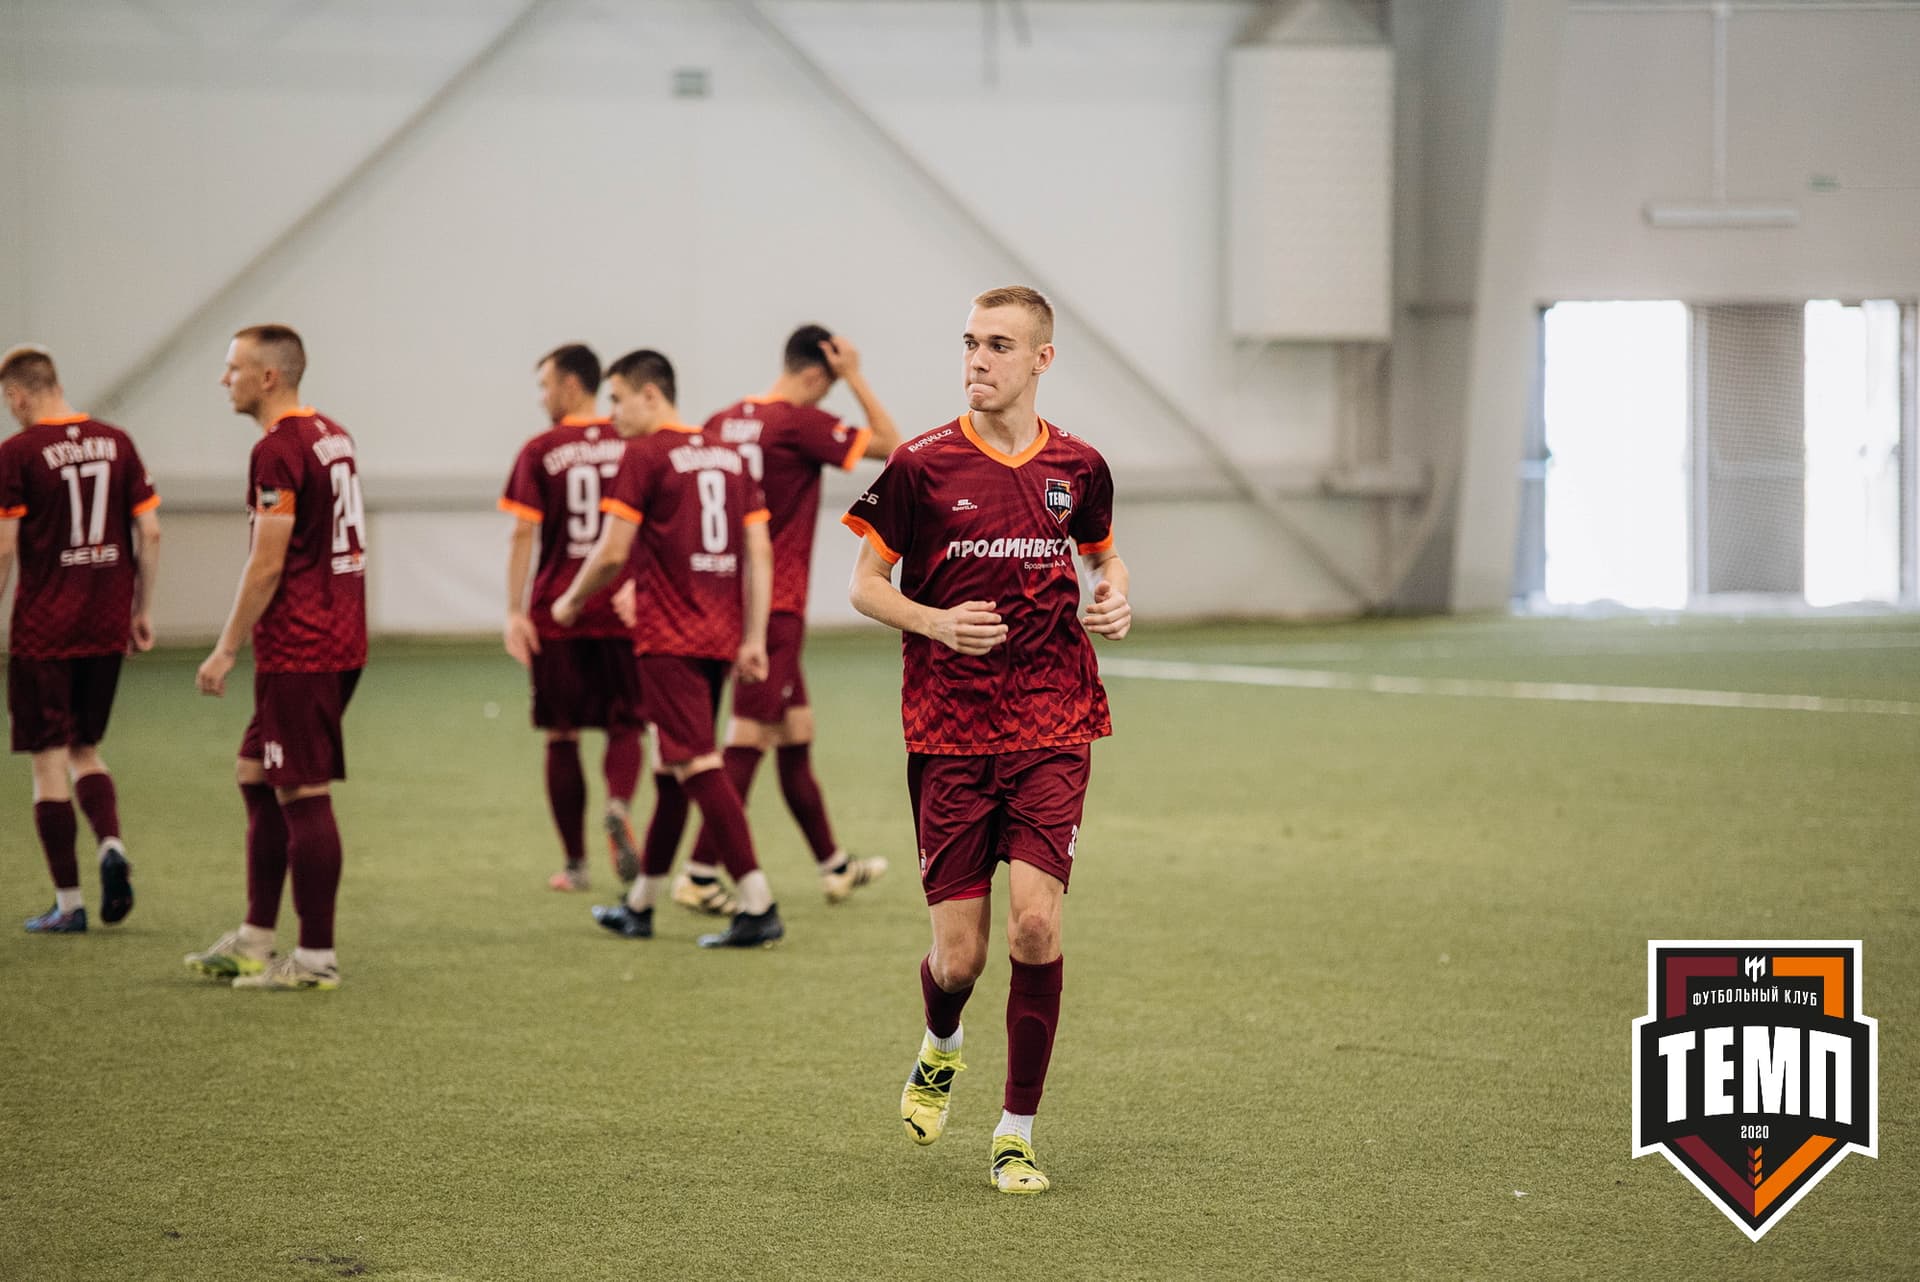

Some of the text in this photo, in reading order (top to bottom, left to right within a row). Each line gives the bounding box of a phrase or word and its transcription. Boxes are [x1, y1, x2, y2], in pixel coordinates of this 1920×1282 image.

[60, 461, 110, 547] 17
[330, 462, 366, 554] 24
[697, 469, 729, 554] 8
[1048, 491, 1071, 508] ТЕМП
